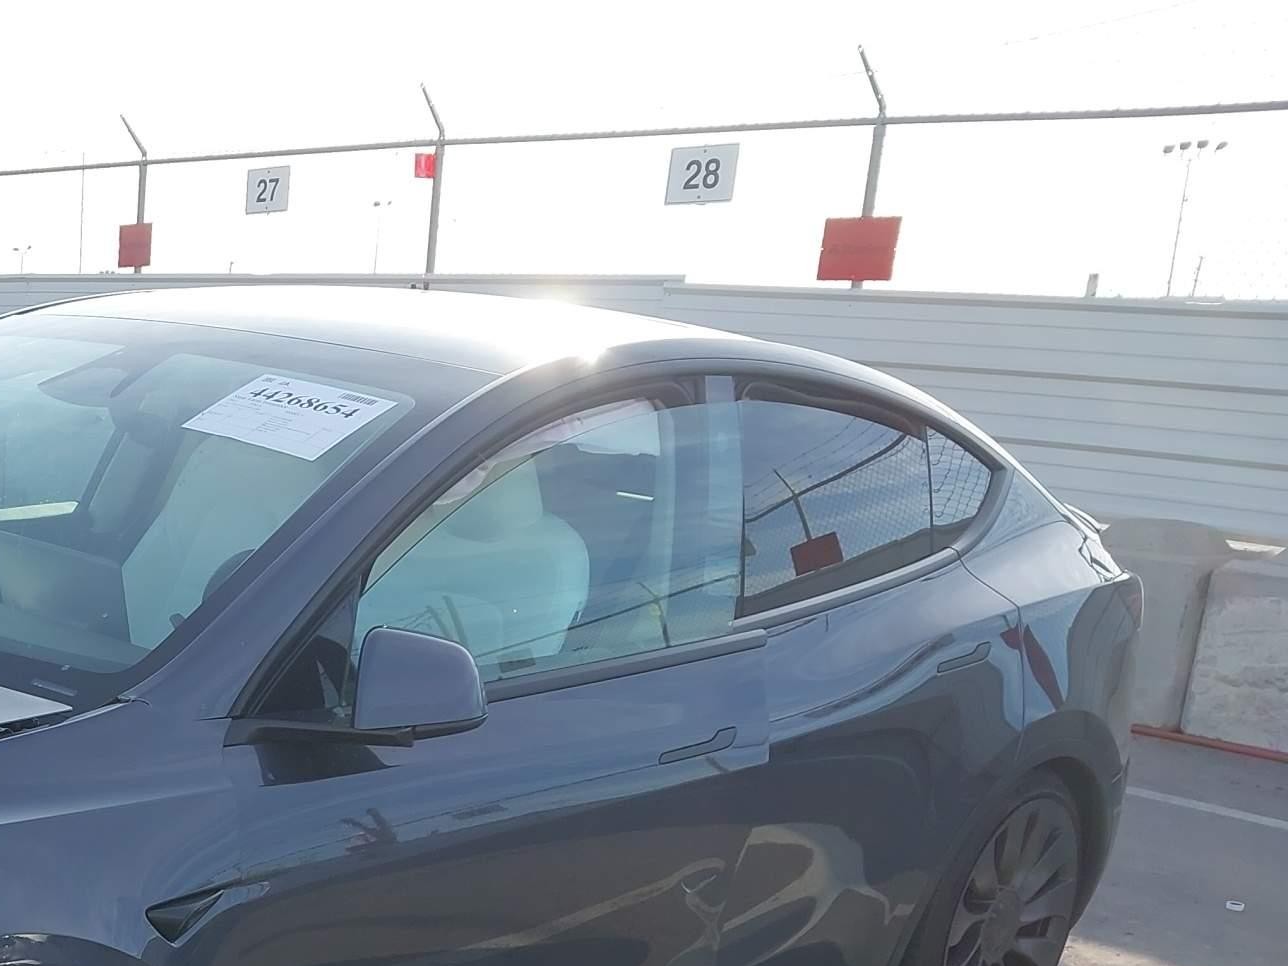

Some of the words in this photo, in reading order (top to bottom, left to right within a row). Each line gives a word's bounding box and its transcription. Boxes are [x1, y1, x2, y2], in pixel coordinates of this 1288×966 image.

[683, 158, 721, 190] 28
[256, 178, 280, 203] 27
[250, 388, 360, 419] 44268654
